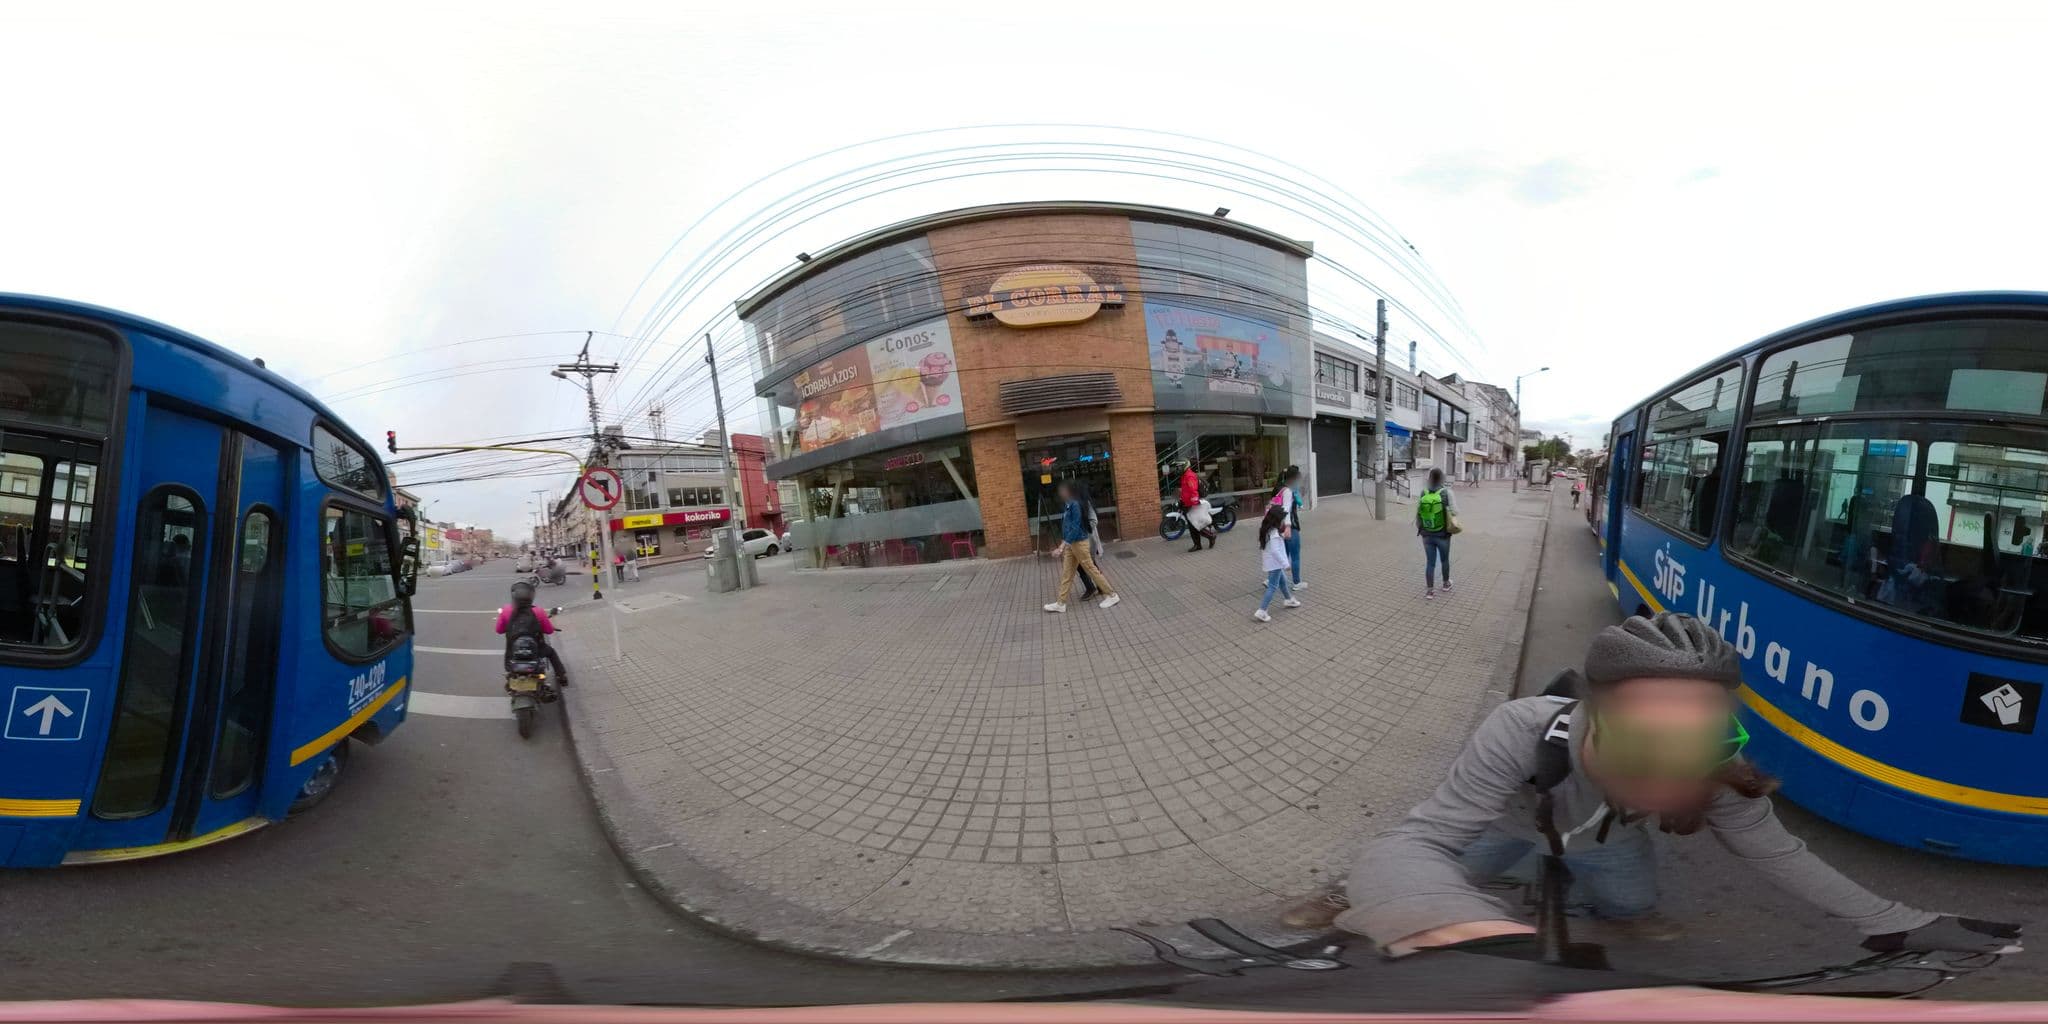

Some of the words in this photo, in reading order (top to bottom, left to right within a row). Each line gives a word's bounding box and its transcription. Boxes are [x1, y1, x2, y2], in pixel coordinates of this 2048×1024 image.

[967, 294, 1002, 314] EL
[1010, 285, 1122, 308] CORRAL
[685, 511, 721, 522] kokoriko
[1697, 578, 1890, 732] Urbano
